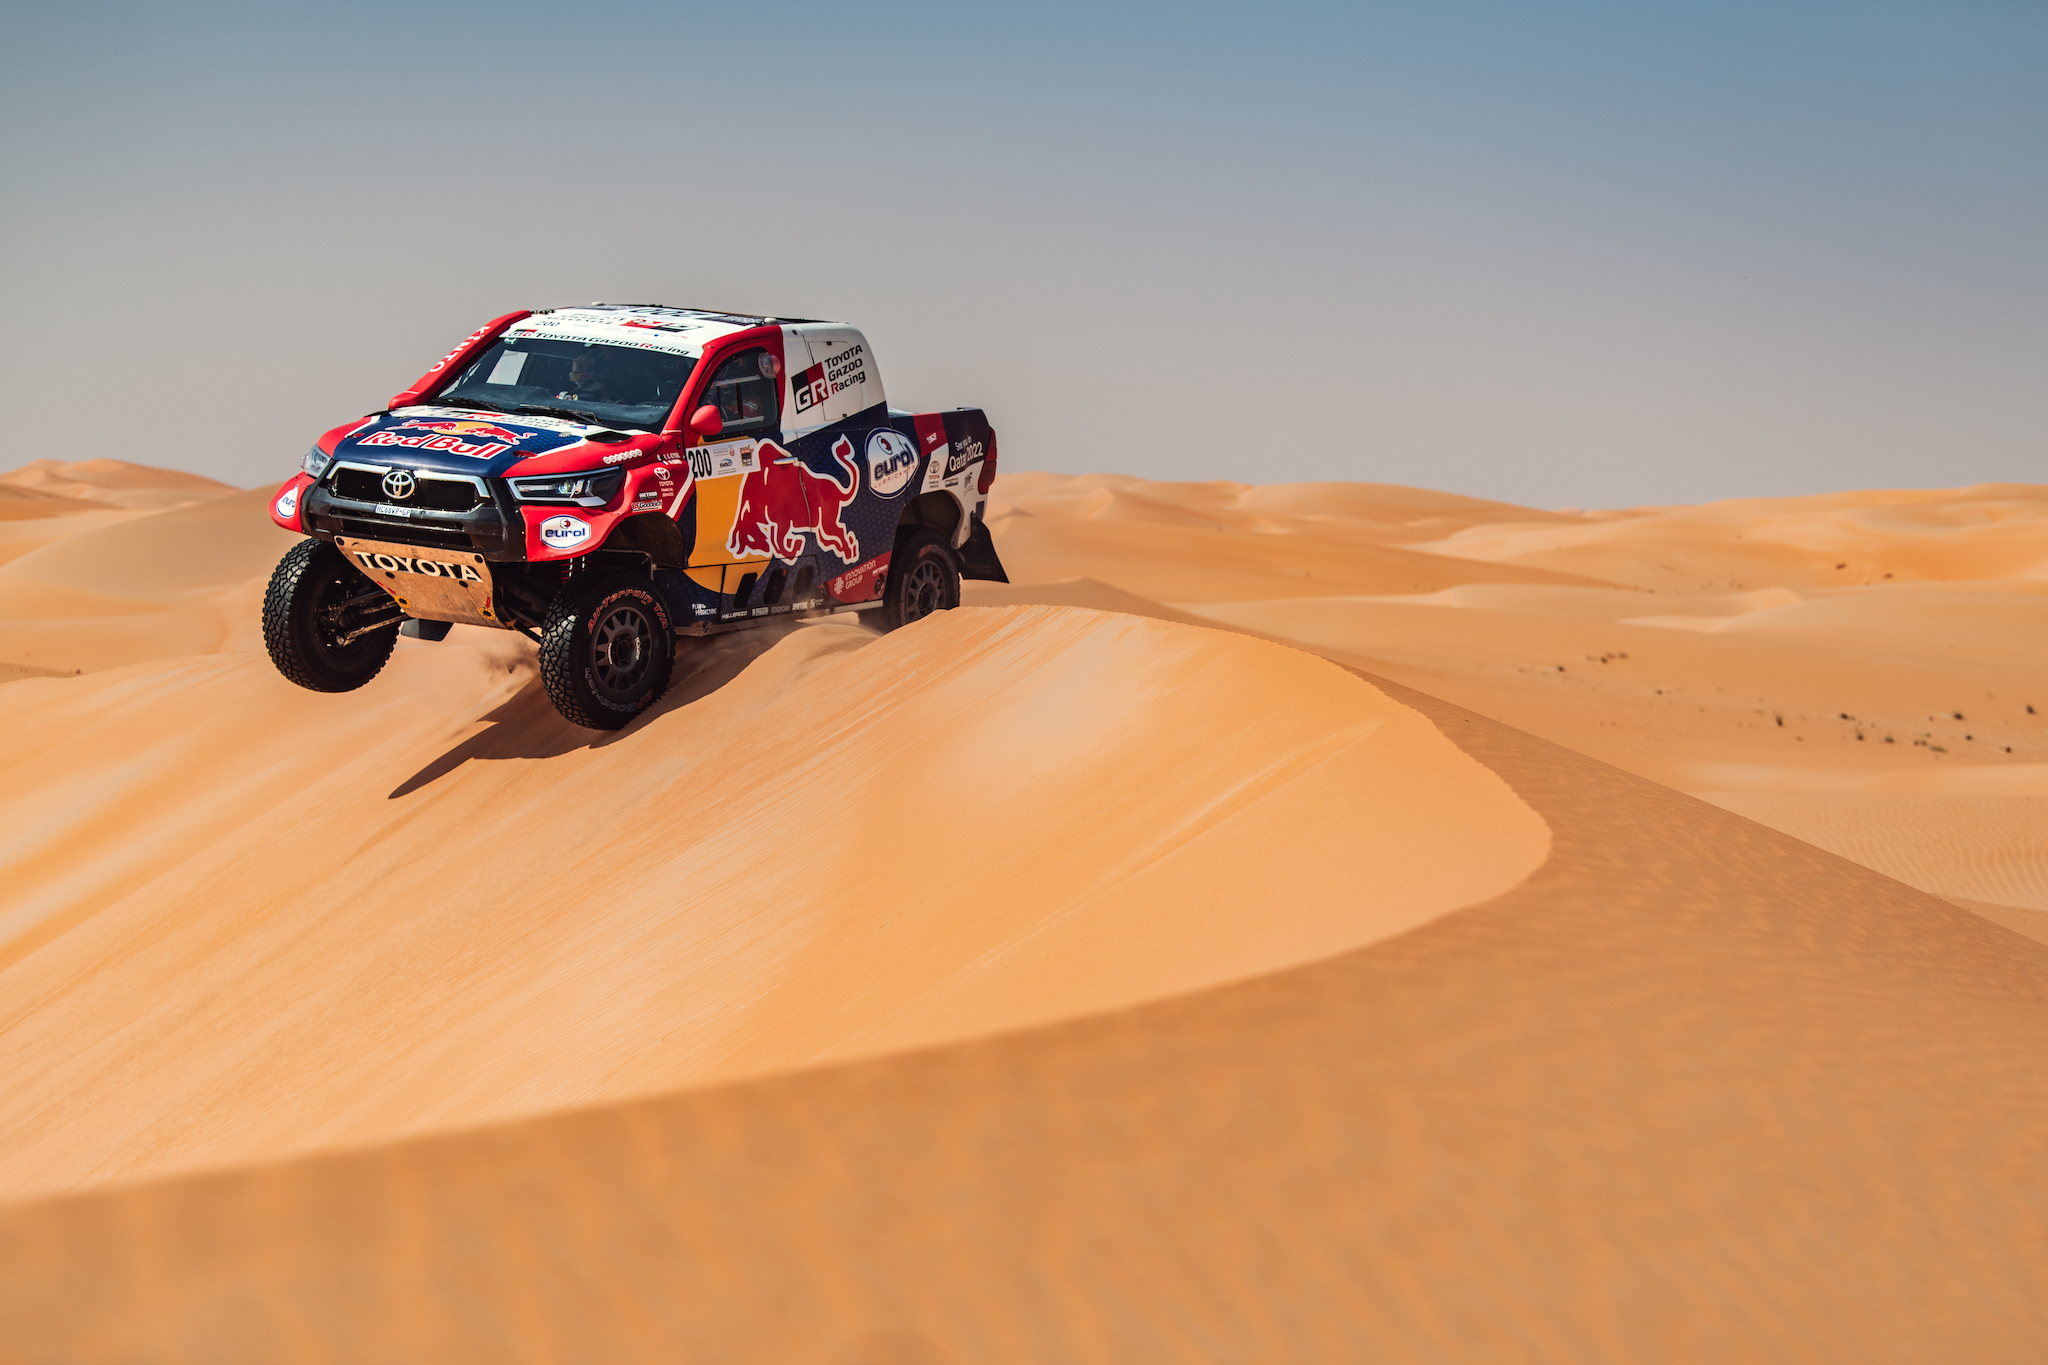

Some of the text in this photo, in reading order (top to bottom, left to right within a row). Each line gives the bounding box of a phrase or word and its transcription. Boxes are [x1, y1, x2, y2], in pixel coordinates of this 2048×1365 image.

[536, 333, 587, 341] TOYOTA
[588, 337, 639, 347] GAZOO
[639, 343, 691, 355] Racing
[824, 344, 863, 369] TOYOTA
[828, 358, 863, 382] GAZOO
[830, 371, 866, 394] Racing
[795, 377, 828, 411] GR
[357, 431, 512, 460] Red Bull
[926, 432, 938, 444] SKF
[688, 448, 712, 478] 200
[874, 442, 915, 481] eurol
[949, 441, 984, 472] Qatar 2022
[873, 465, 915, 488] LUBRICANTS
[545, 527, 586, 538] eurol
[352, 551, 484, 583] TOYOTA
[845, 574, 864, 590] GROUP
[587, 588, 669, 634] All-Terrain T/A
